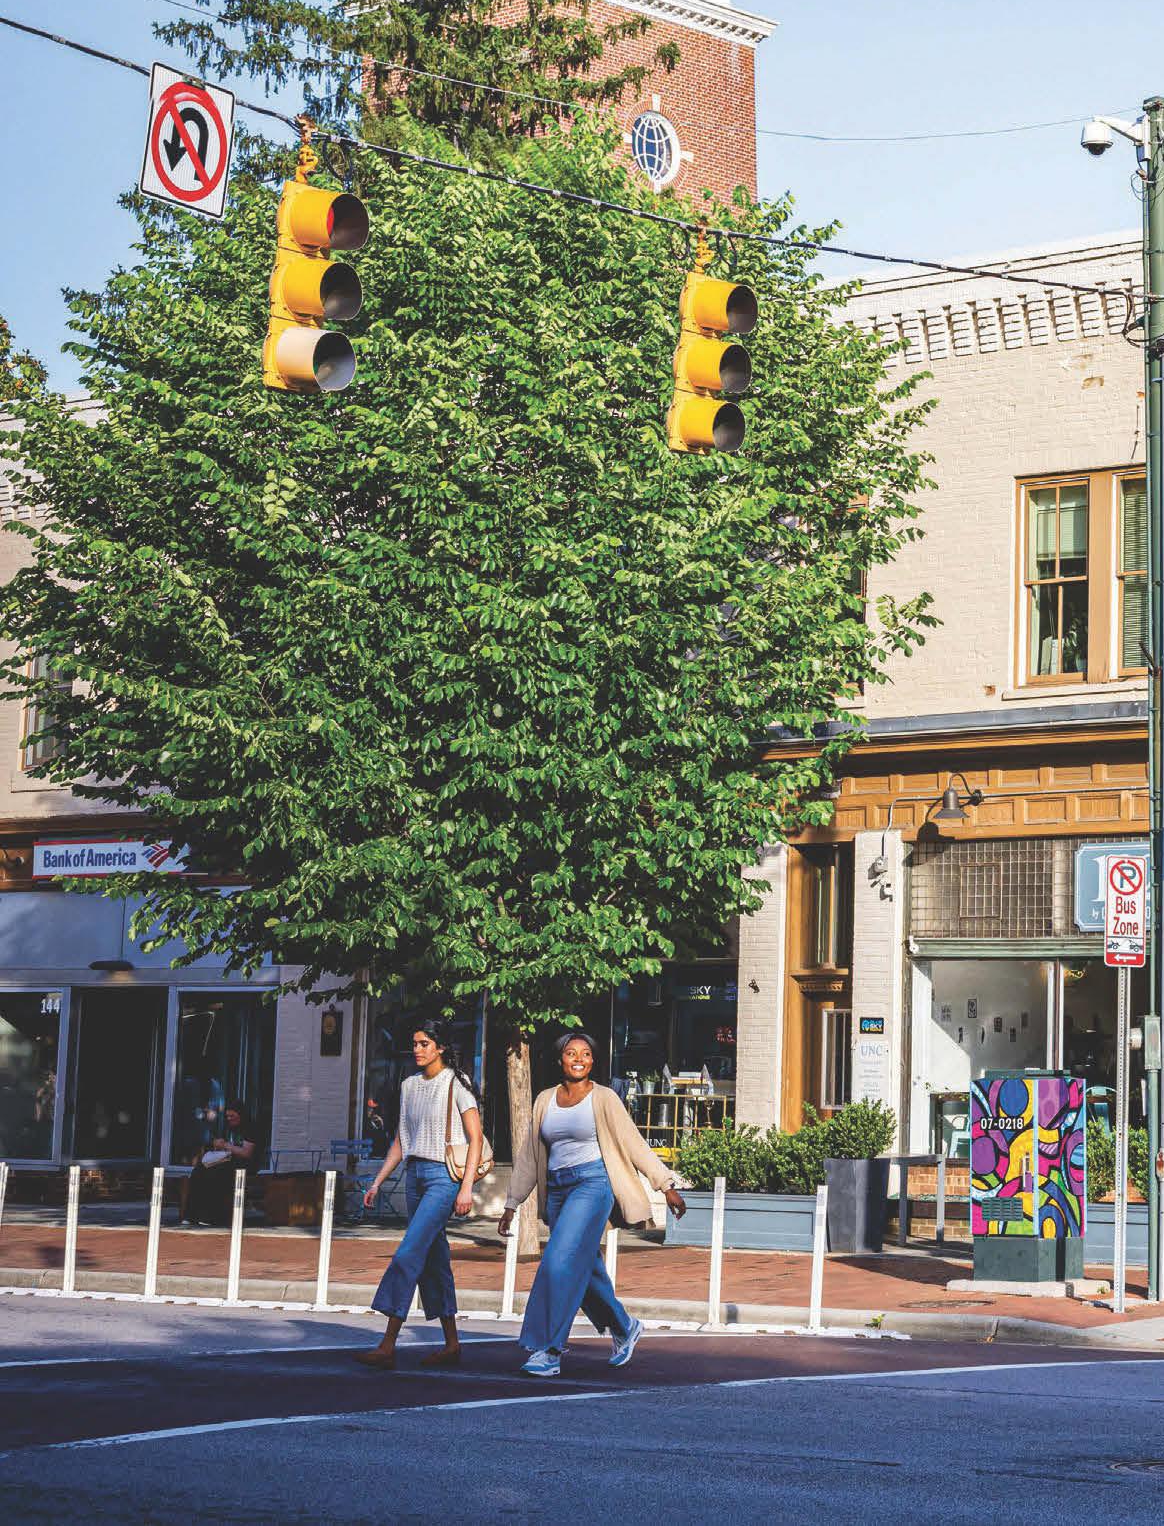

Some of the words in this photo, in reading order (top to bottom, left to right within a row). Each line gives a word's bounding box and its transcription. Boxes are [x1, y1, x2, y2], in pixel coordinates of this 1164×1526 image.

[43, 849, 71, 868] Bank
[72, 849, 86, 867] of
[86, 848, 137, 867] America
[1115, 896, 1137, 915] Bus
[1113, 916, 1139, 936] Zone
[690, 986, 711, 994] SKY
[41, 998, 60, 1014] 144
[861, 1045, 883, 1057] UNC
[980, 1117, 1025, 1130] 07-0218
